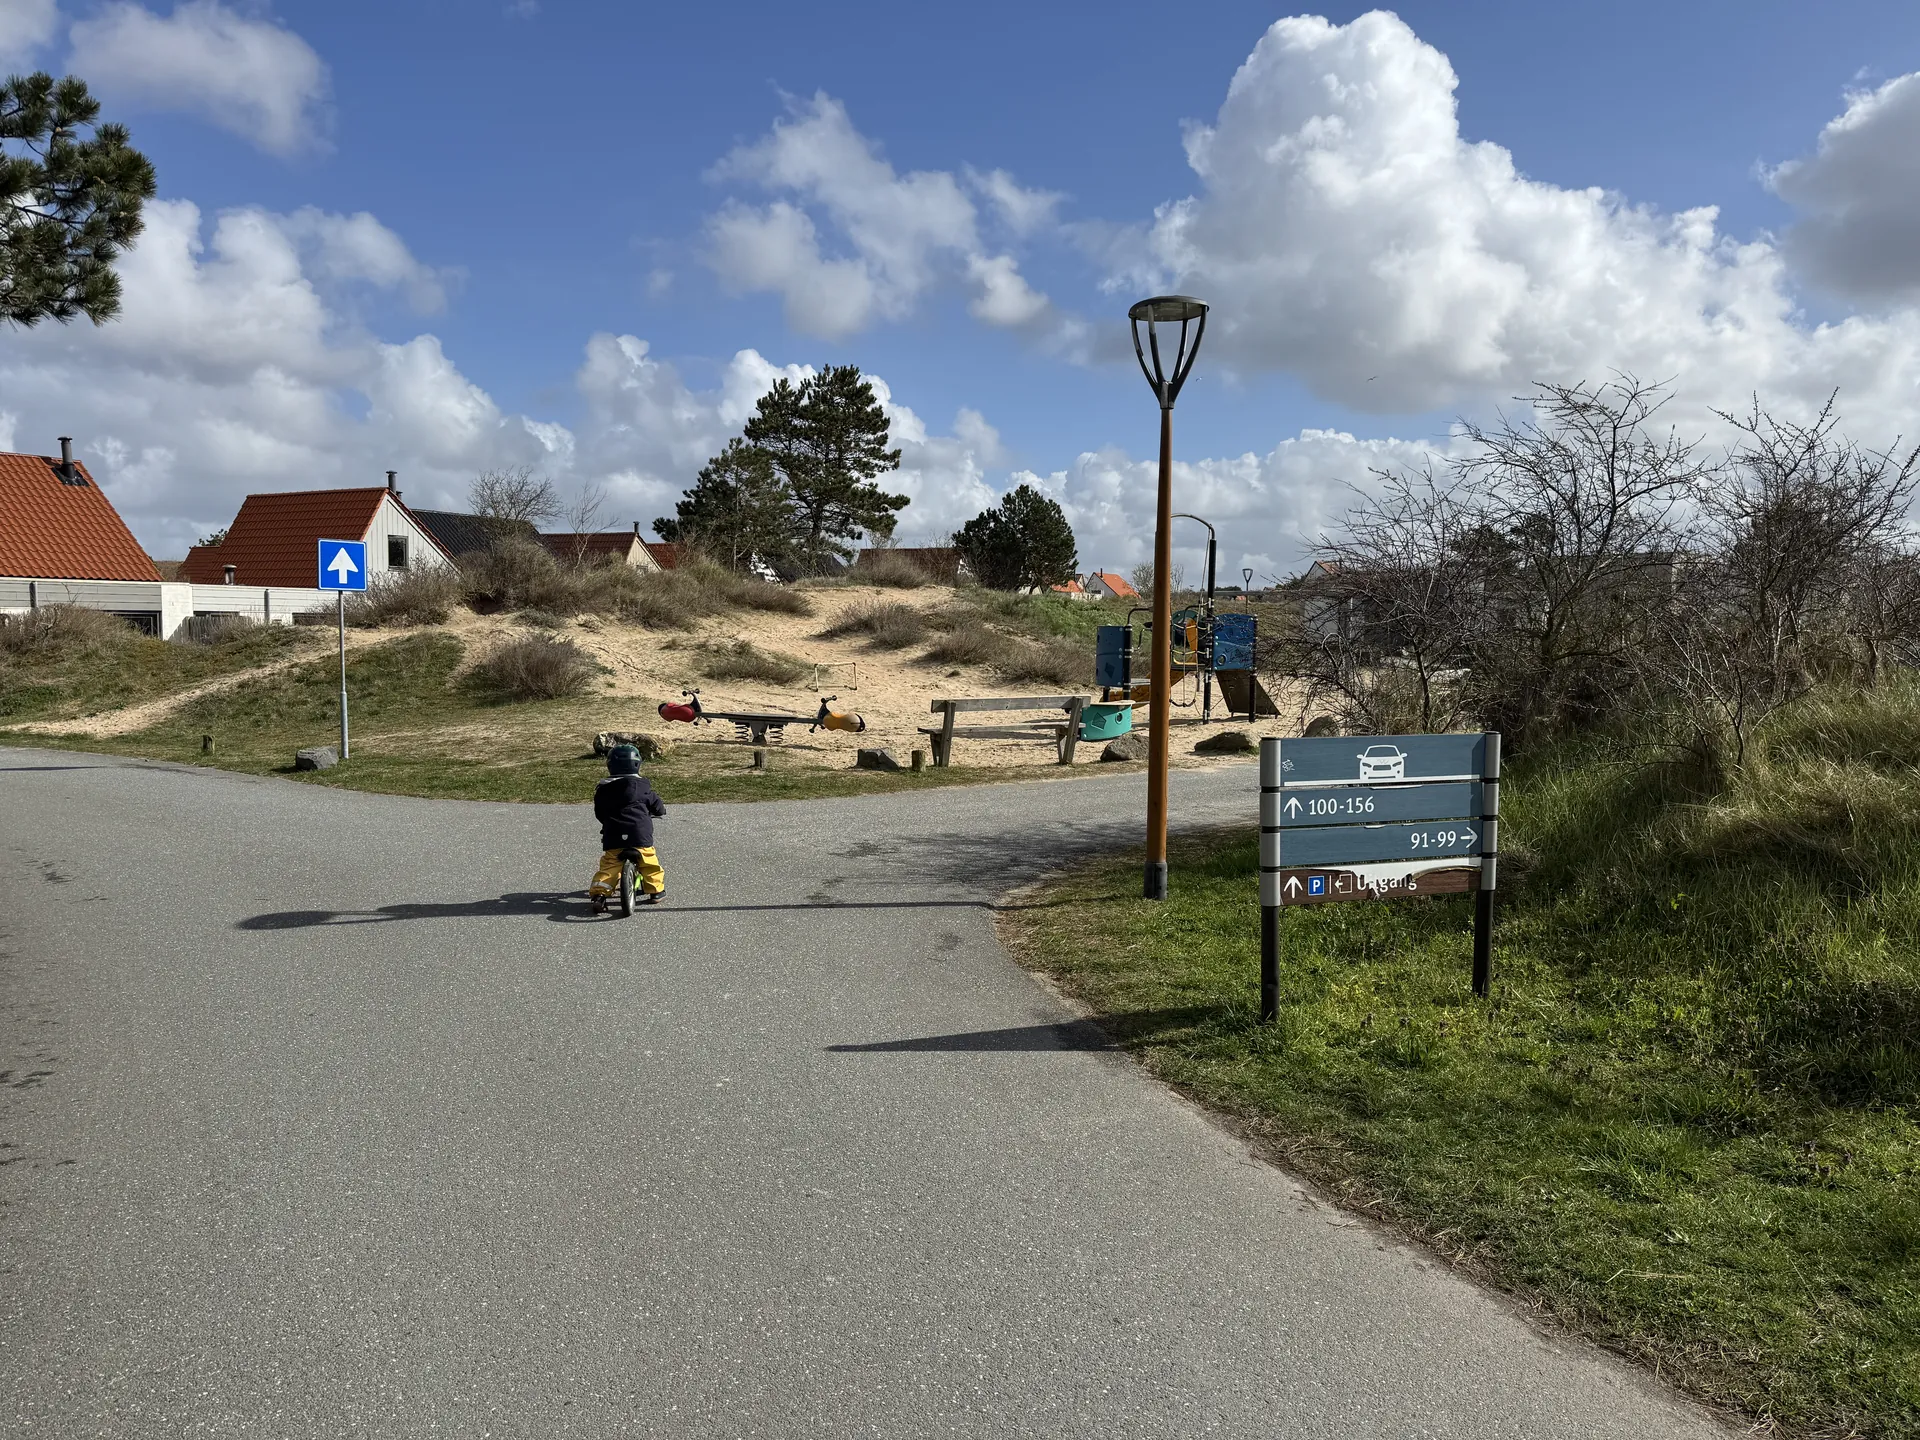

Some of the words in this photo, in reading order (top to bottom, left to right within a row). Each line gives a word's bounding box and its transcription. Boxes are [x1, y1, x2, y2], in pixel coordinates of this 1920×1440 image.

[1308, 796, 1375, 815] 100-156
[1410, 830, 1457, 850] 91-99
[1312, 879, 1321, 893] P
